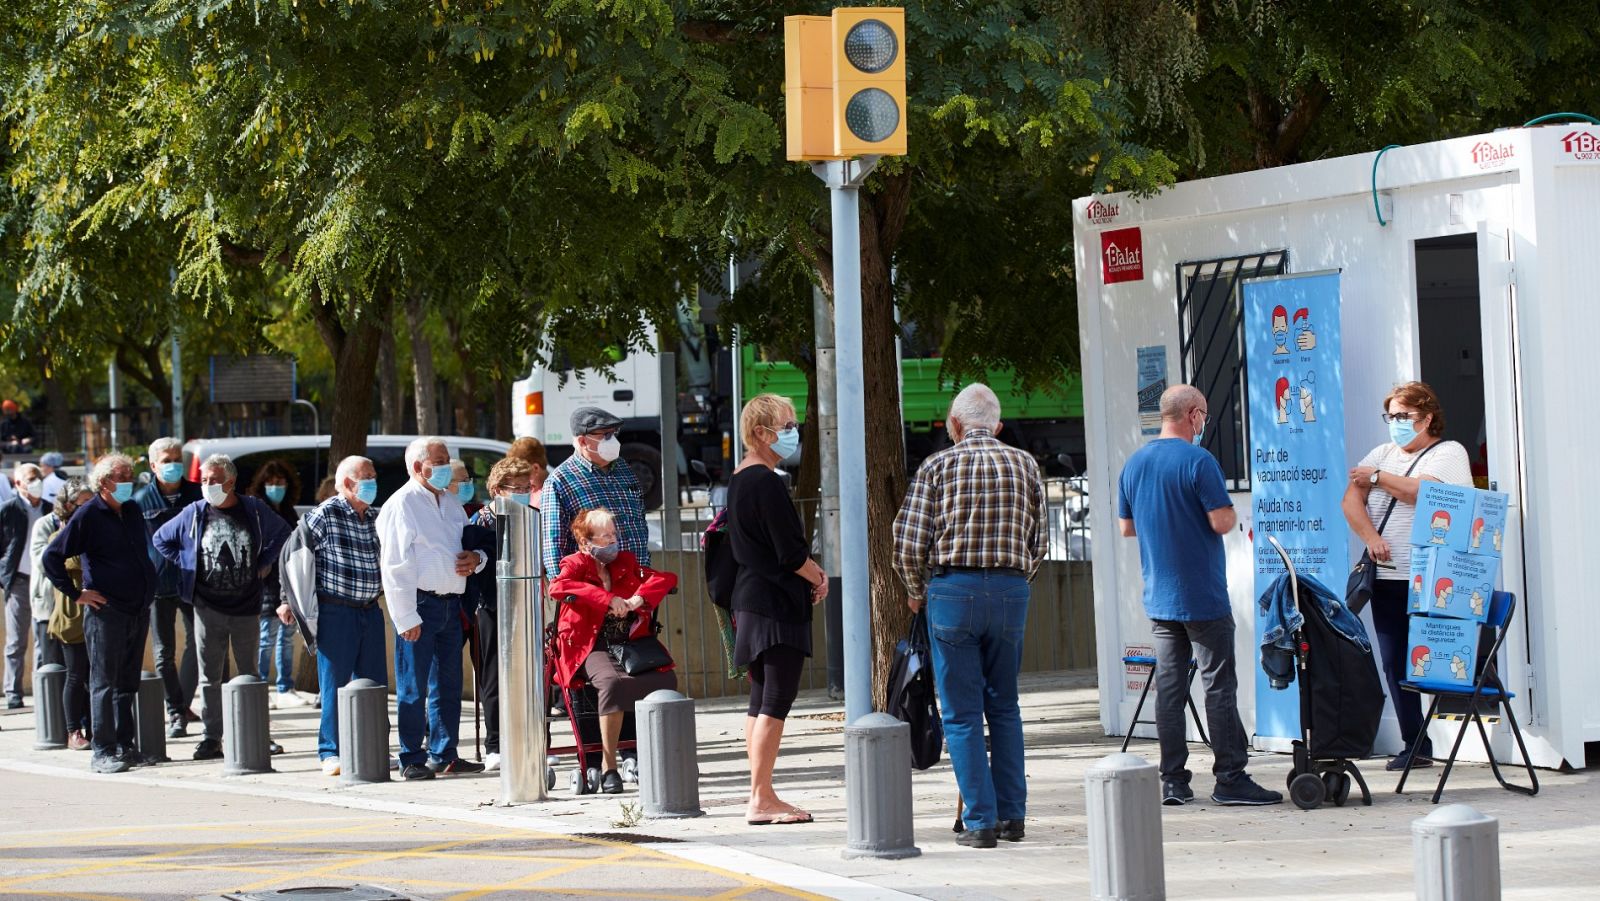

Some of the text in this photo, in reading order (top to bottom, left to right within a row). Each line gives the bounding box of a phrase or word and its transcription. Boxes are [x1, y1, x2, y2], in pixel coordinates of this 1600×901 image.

[1479, 142, 1514, 162] Balat
[1091, 201, 1119, 218] Balat
[1105, 242, 1140, 267] Balat
[1256, 448, 1289, 463] Punt de
[1257, 466, 1328, 484] vacunació segur.
[1258, 498, 1302, 516] Ajuda'ns a
[1258, 517, 1325, 532] mantenir-lo net.
[1452, 556, 1484, 567] Mantingues
[1426, 622, 1461, 631] Mantingues
